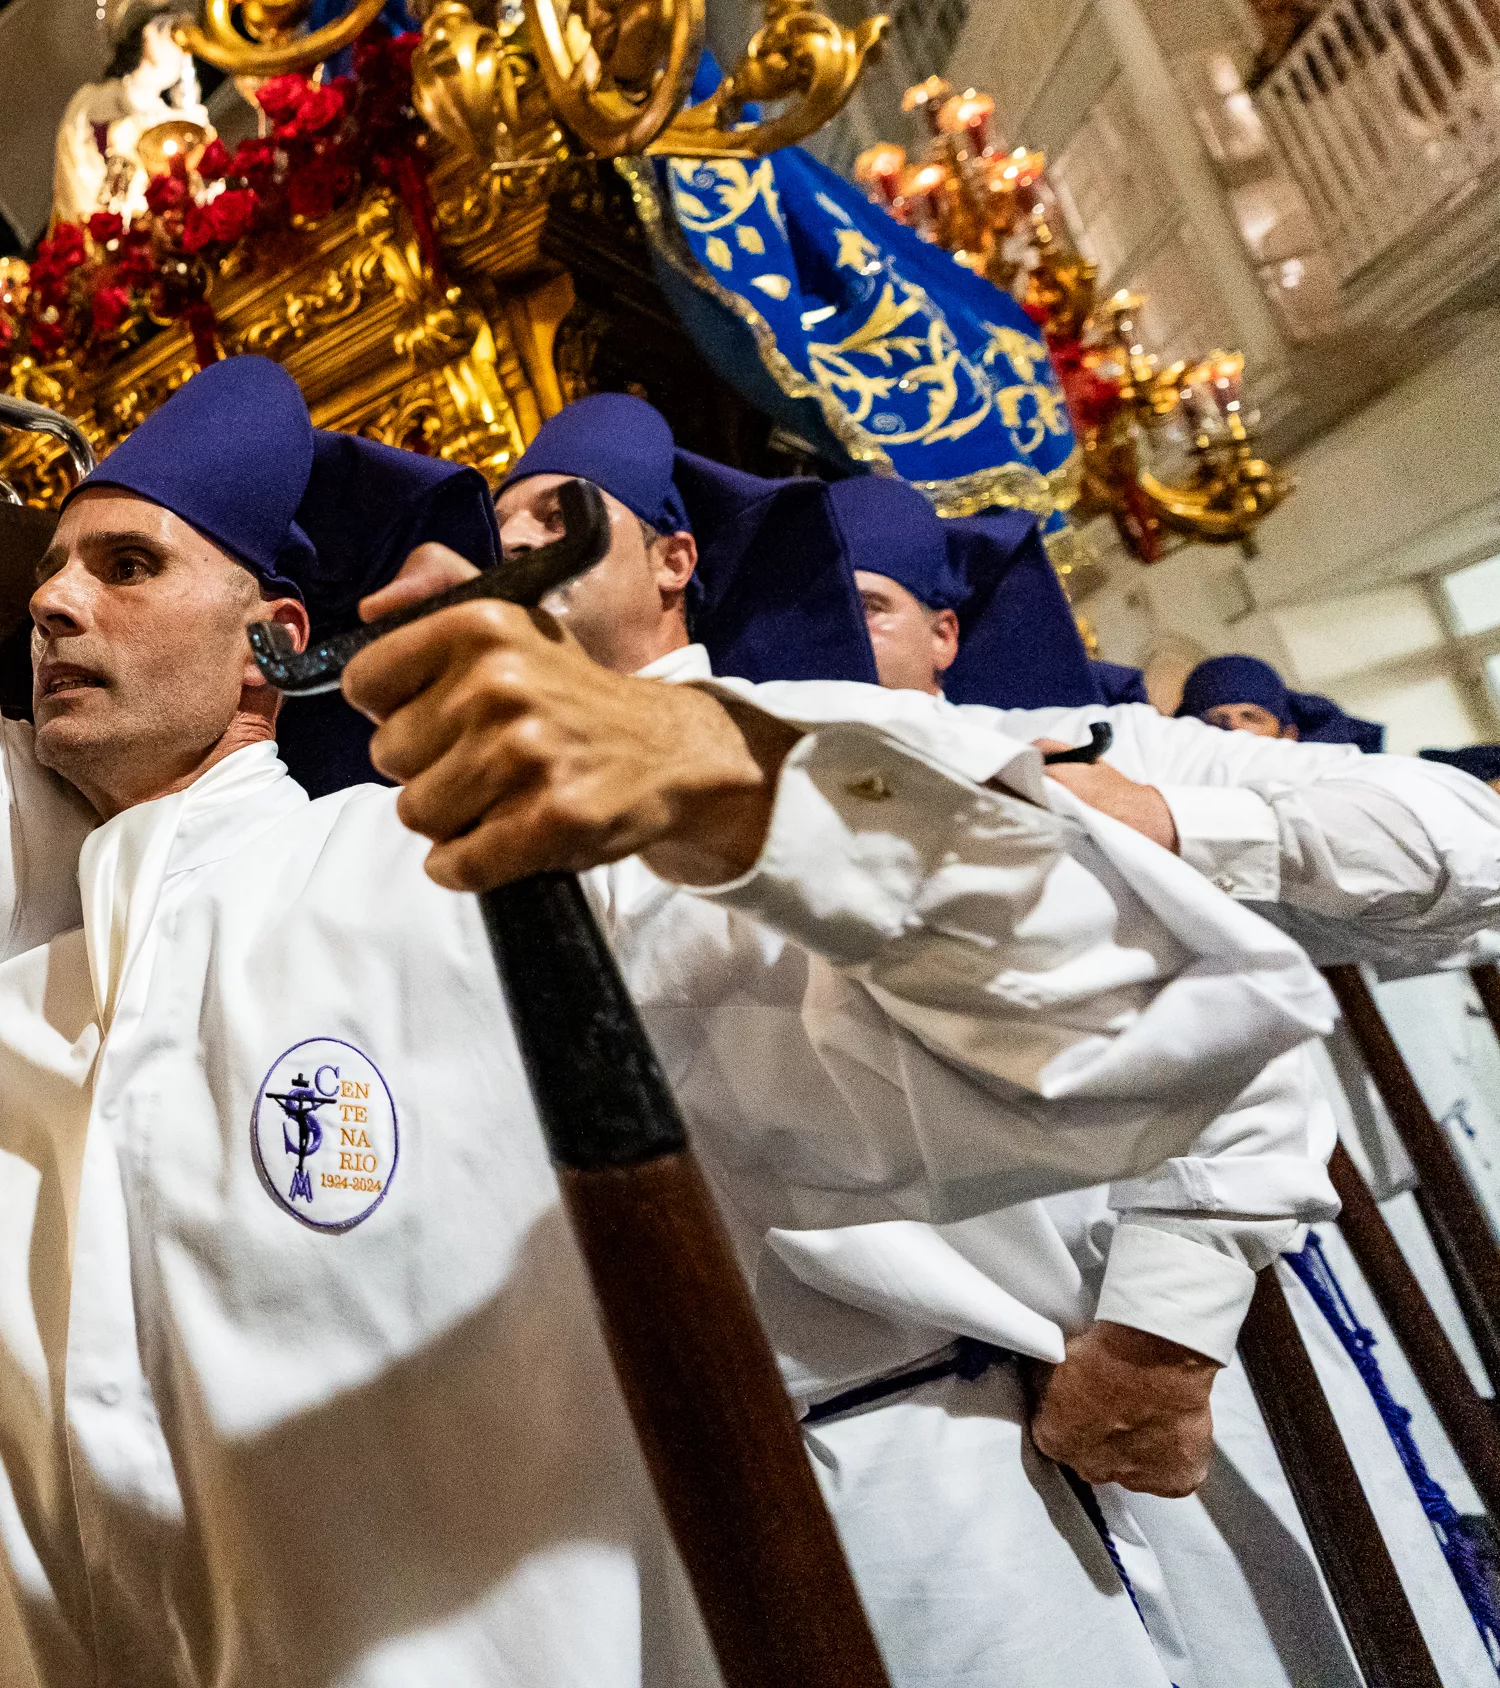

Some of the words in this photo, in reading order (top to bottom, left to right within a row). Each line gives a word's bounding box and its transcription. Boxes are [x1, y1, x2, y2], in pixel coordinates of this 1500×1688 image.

[315, 1065, 370, 1098] CEN
[340, 1104, 368, 1122] TE
[341, 1128, 372, 1147] NA
[340, 1152, 377, 1172] RIO
[321, 1173, 382, 1192] 1924-2024
